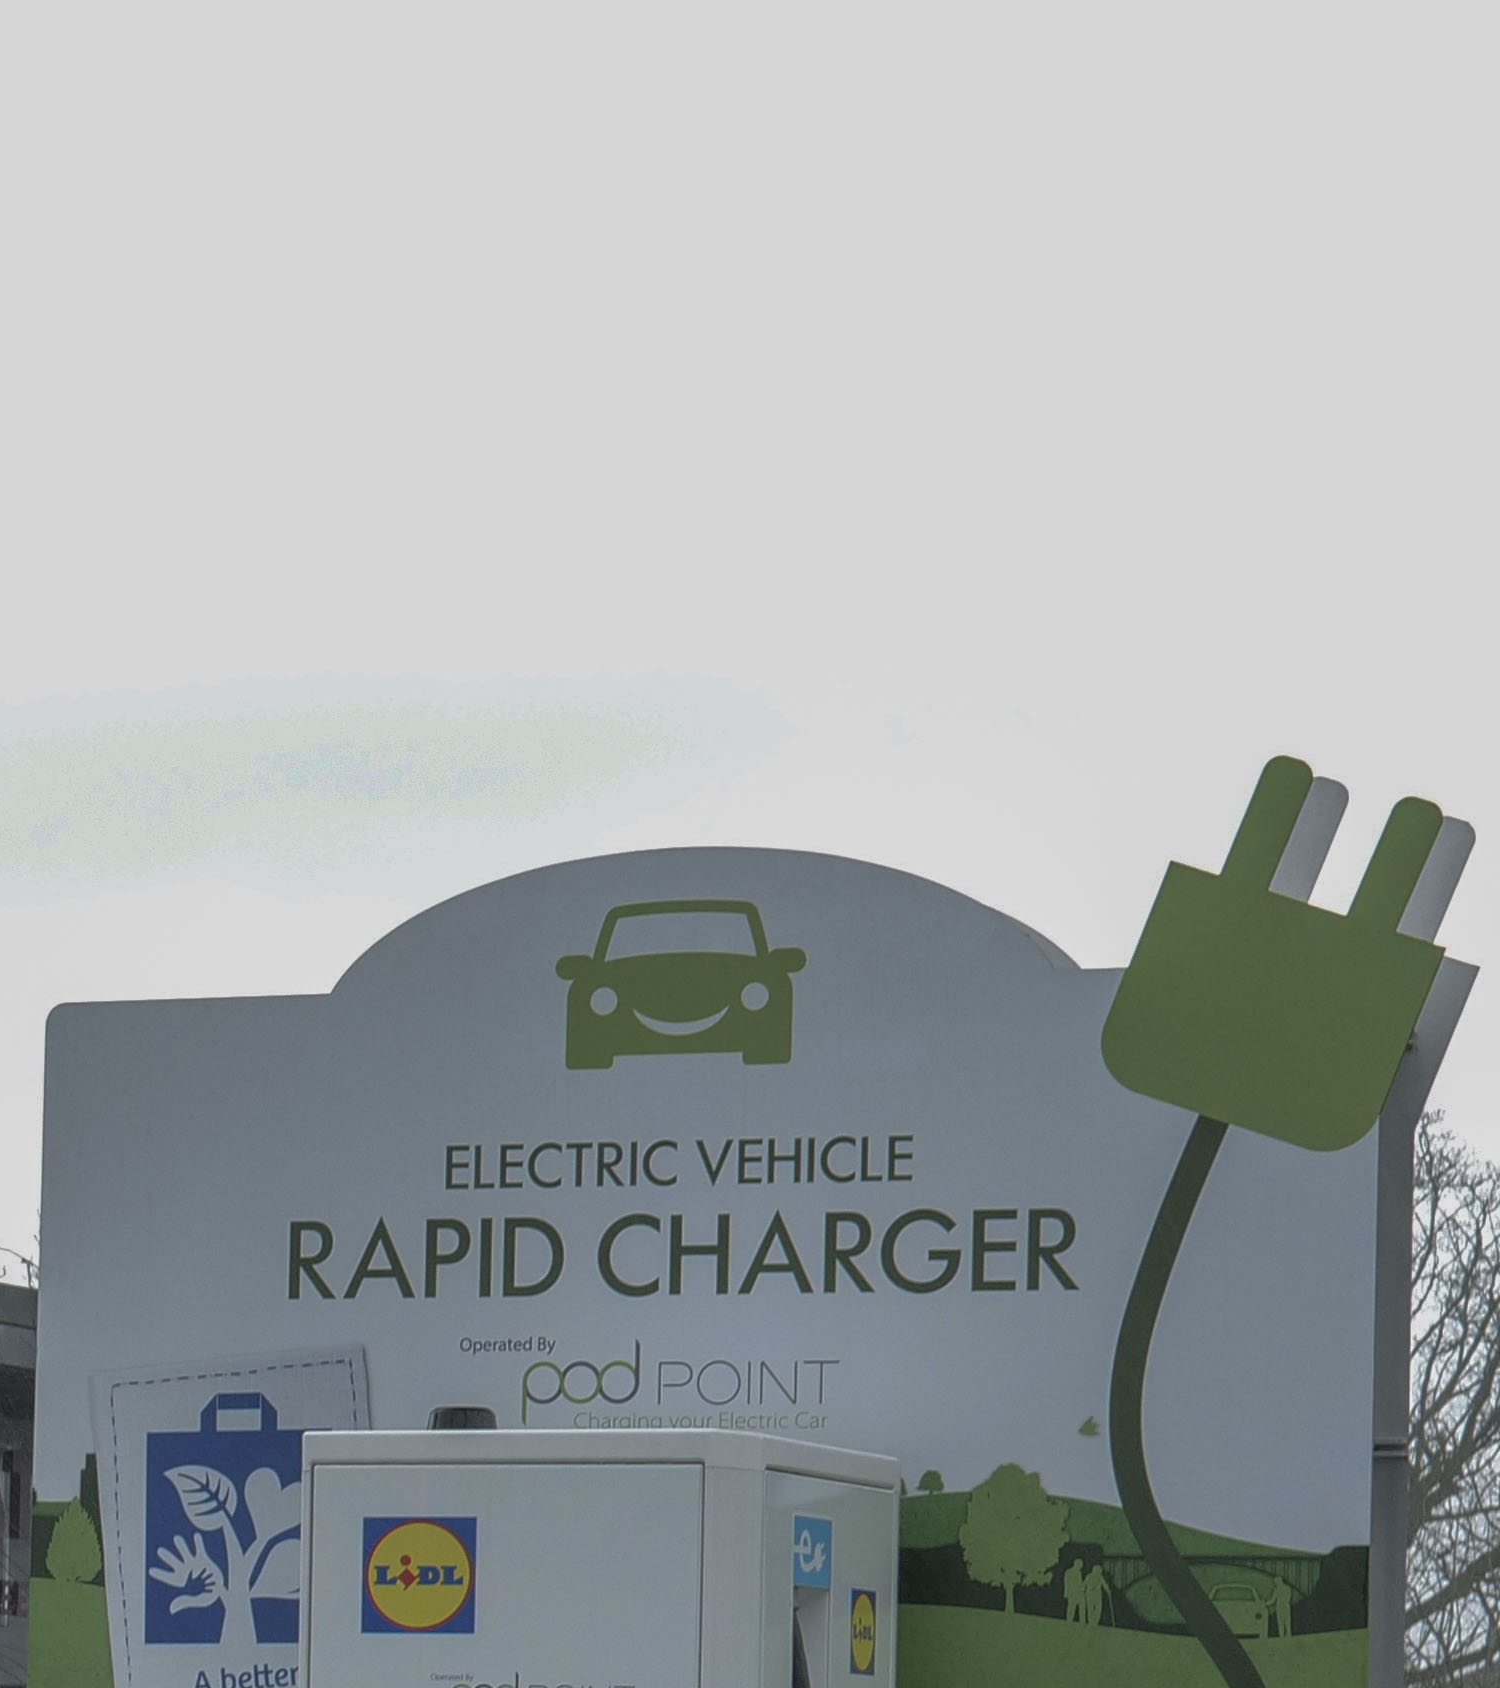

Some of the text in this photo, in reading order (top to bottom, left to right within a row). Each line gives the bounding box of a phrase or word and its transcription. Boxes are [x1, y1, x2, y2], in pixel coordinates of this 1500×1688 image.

[443, 1135, 915, 1191] ELECTRIC VEHICLE
[285, 1207, 1081, 1301] RAPID CHARGER
[459, 1336, 557, 1356] Operated By
[521, 1338, 841, 1426] pod POINT
[719, 1410, 790, 1429] Electric
[795, 1411, 828, 1430] Car
